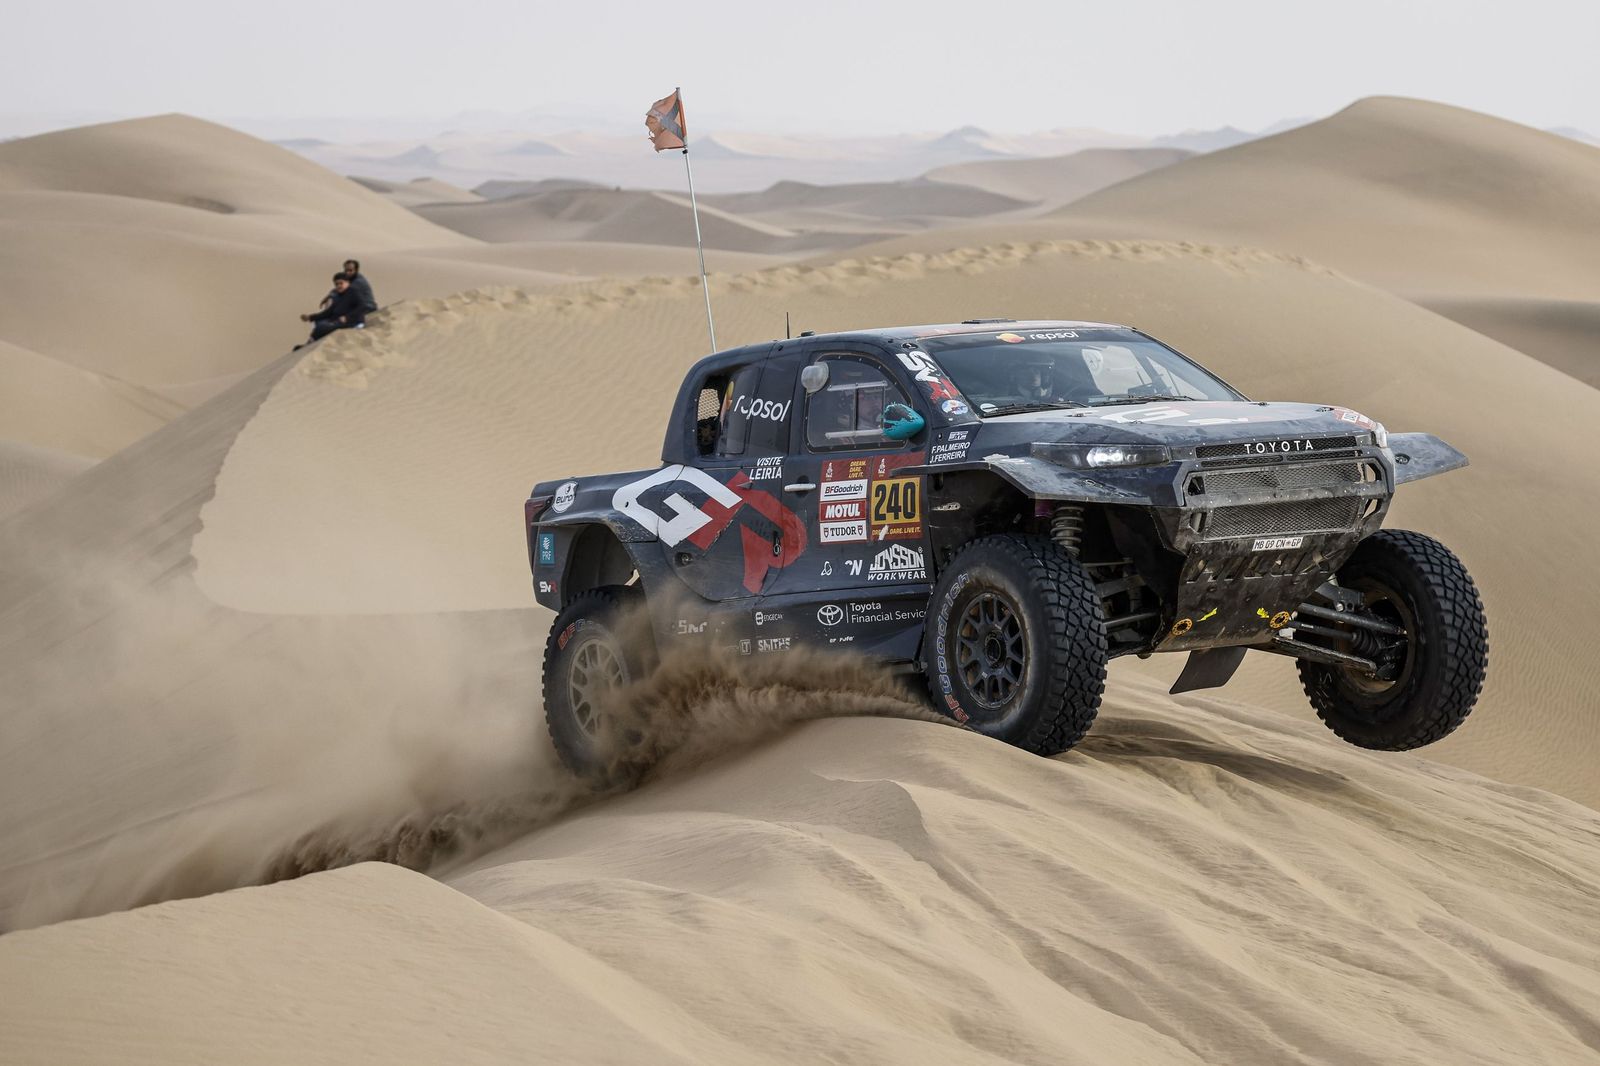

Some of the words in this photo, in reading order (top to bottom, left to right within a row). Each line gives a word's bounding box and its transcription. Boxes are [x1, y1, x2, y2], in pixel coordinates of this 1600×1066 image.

[1030, 331, 1079, 340] repsol
[1244, 440, 1313, 454] TOYOTA
[757, 456, 784, 466] VISITE
[930, 450, 966, 463] J.FERREIRA
[749, 467, 782, 480] LEIRIA
[825, 484, 863, 494] BFGoodrich
[874, 482, 916, 521] 240
[825, 503, 860, 518] MOTUL
[830, 526, 857, 536] TUDOR
[867, 571, 927, 580] WORKWEAR
[850, 602, 881, 613] Toyota
[851, 612, 893, 623] Financial
